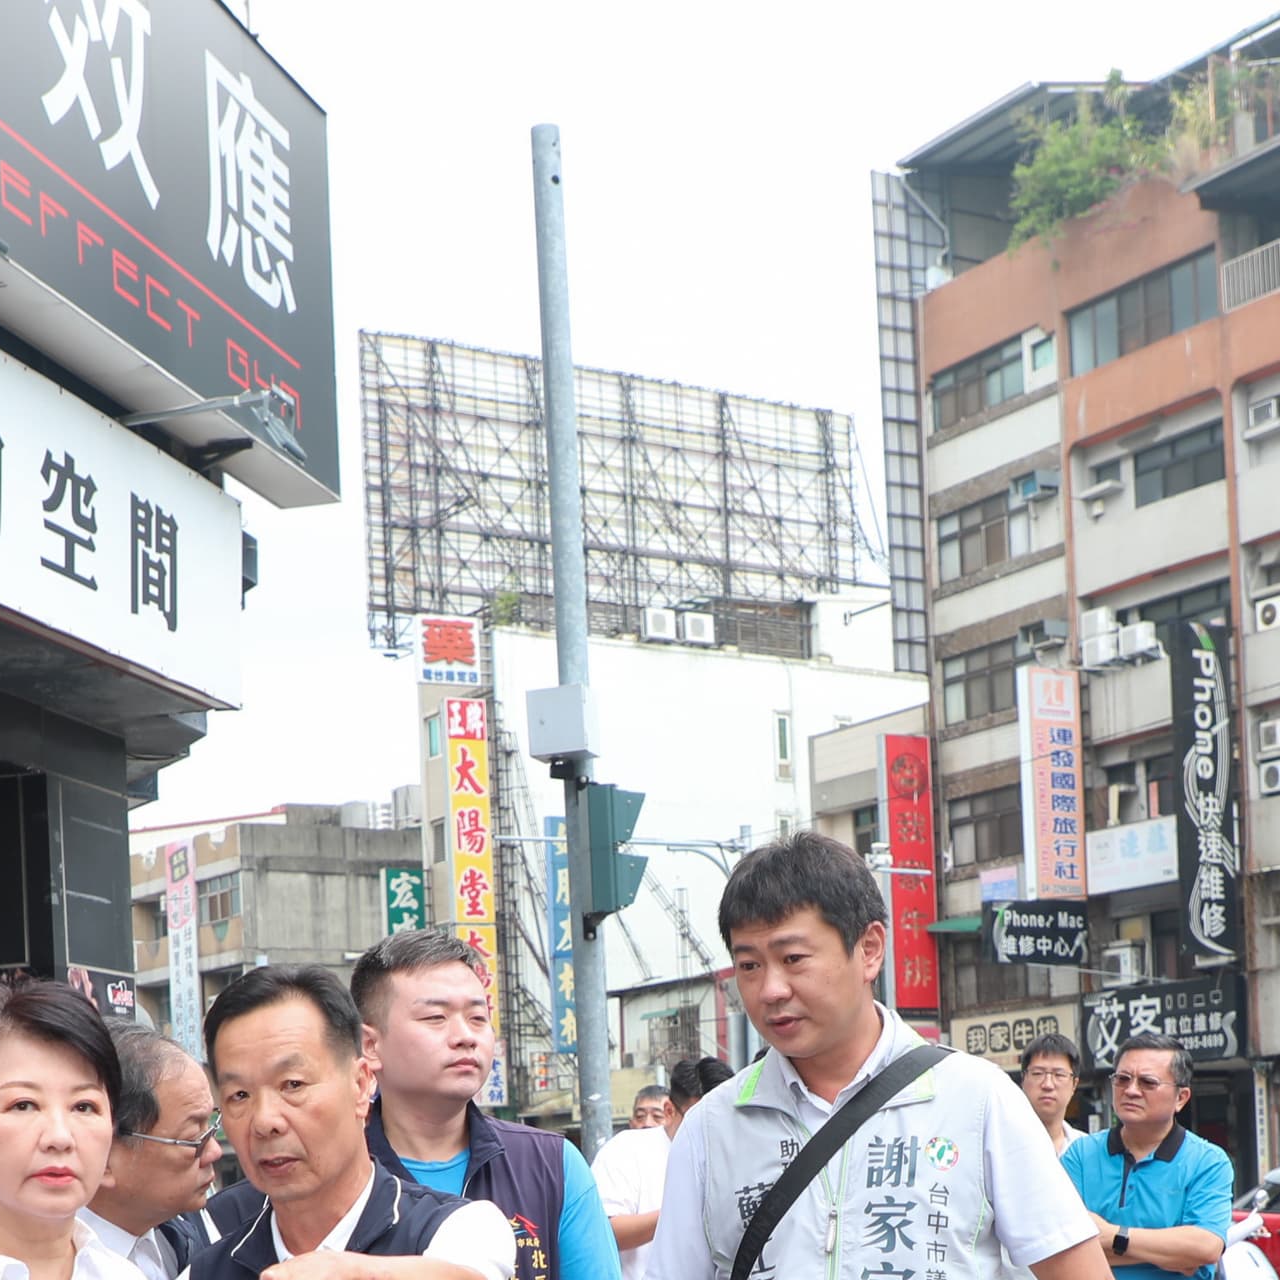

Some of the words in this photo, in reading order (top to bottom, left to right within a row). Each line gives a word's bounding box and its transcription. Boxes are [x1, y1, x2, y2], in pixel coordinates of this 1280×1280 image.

[0, 159, 200, 348] EFFECT
[422, 619, 476, 666] 藥
[454, 746, 489, 917] 太陽堂
[1198, 790, 1226, 938] 快速維修
[1057, 910, 1085, 929] Mac
